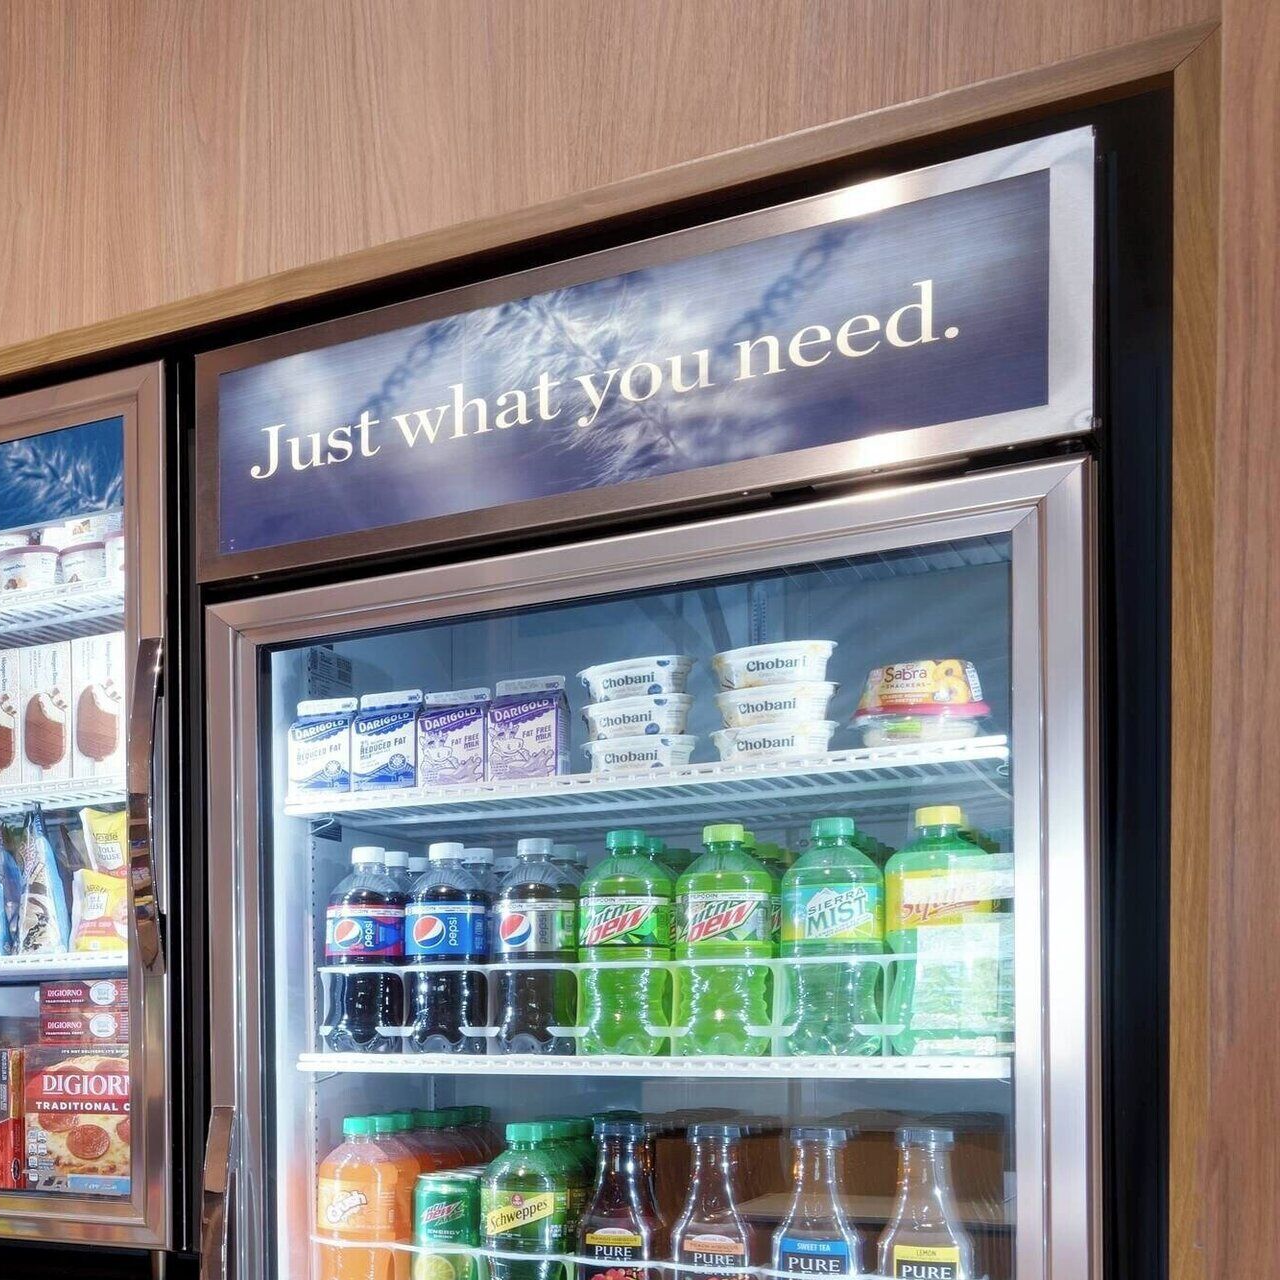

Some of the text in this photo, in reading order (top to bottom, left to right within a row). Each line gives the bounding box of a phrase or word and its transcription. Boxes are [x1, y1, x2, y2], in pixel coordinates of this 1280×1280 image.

[250, 279, 961, 480] Just what you need.
[601, 670, 656, 690] Chobani
[884, 665, 929, 684] Sabra
[295, 718, 344, 740] DARIGOLD
[358, 711, 410, 734] DARIGOLD
[424, 707, 477, 731] DARIGOLD
[599, 709, 653, 729] Chobani
[603, 748, 659, 765] Chobani
[808, 886, 865, 915] SIERRA
[806, 899, 867, 935] MIST
[363, 920, 374, 948] pepsi
[448, 917, 459, 946] pepsi
[36, 1101, 119, 1111] TRADITIONAL
[490, 1199, 549, 1228] Schweppes
[594, 1245, 633, 1257] PURE
[797, 1242, 830, 1252] SWEET TEA
[916, 1249, 937, 1257] LEMON
[693, 1252, 735, 1266] PURE
[788, 1256, 840, 1271] PURE
